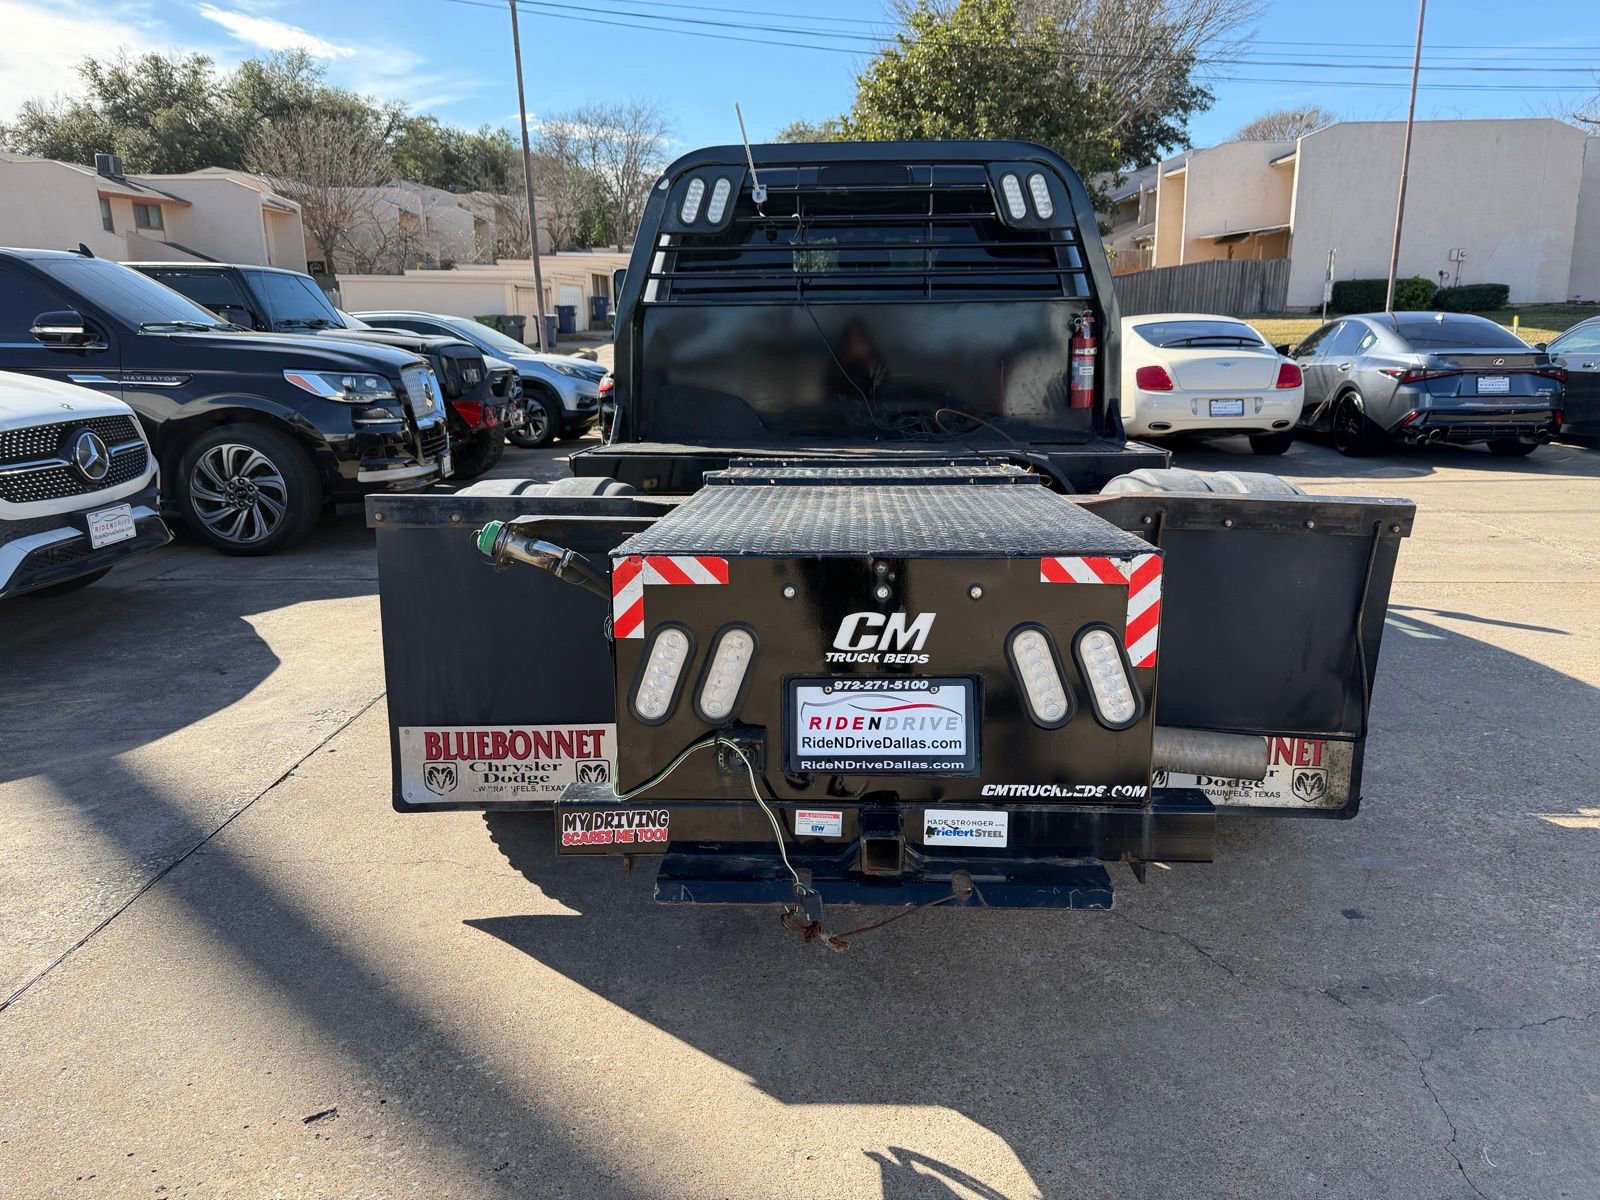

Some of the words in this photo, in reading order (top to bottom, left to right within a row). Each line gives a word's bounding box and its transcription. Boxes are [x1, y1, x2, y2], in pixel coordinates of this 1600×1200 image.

[832, 611, 937, 651] CM
[825, 652, 881, 663] TRUCK
[883, 653, 930, 664] BEDS
[833, 681, 929, 690] 972-271-5100
[808, 716, 958, 730] RIDENDRIVE
[424, 729, 606, 761] BLUEBONNET
[802, 736, 962, 749] RideNDriveDallas.com
[469, 761, 563, 775] Chrysler
[801, 760, 965, 769] RideNDriveDallas.com
[483, 772, 550, 785] Dodge
[1195, 775, 1265, 791] Dodge
[564, 813, 589, 832] MY
[594, 810, 670, 830] DRIVING
[951, 819, 994, 827] STRONGER
[563, 830, 613, 845] SCARES
[616, 829, 635, 842] ME
[638, 828, 669, 842] TOO!
